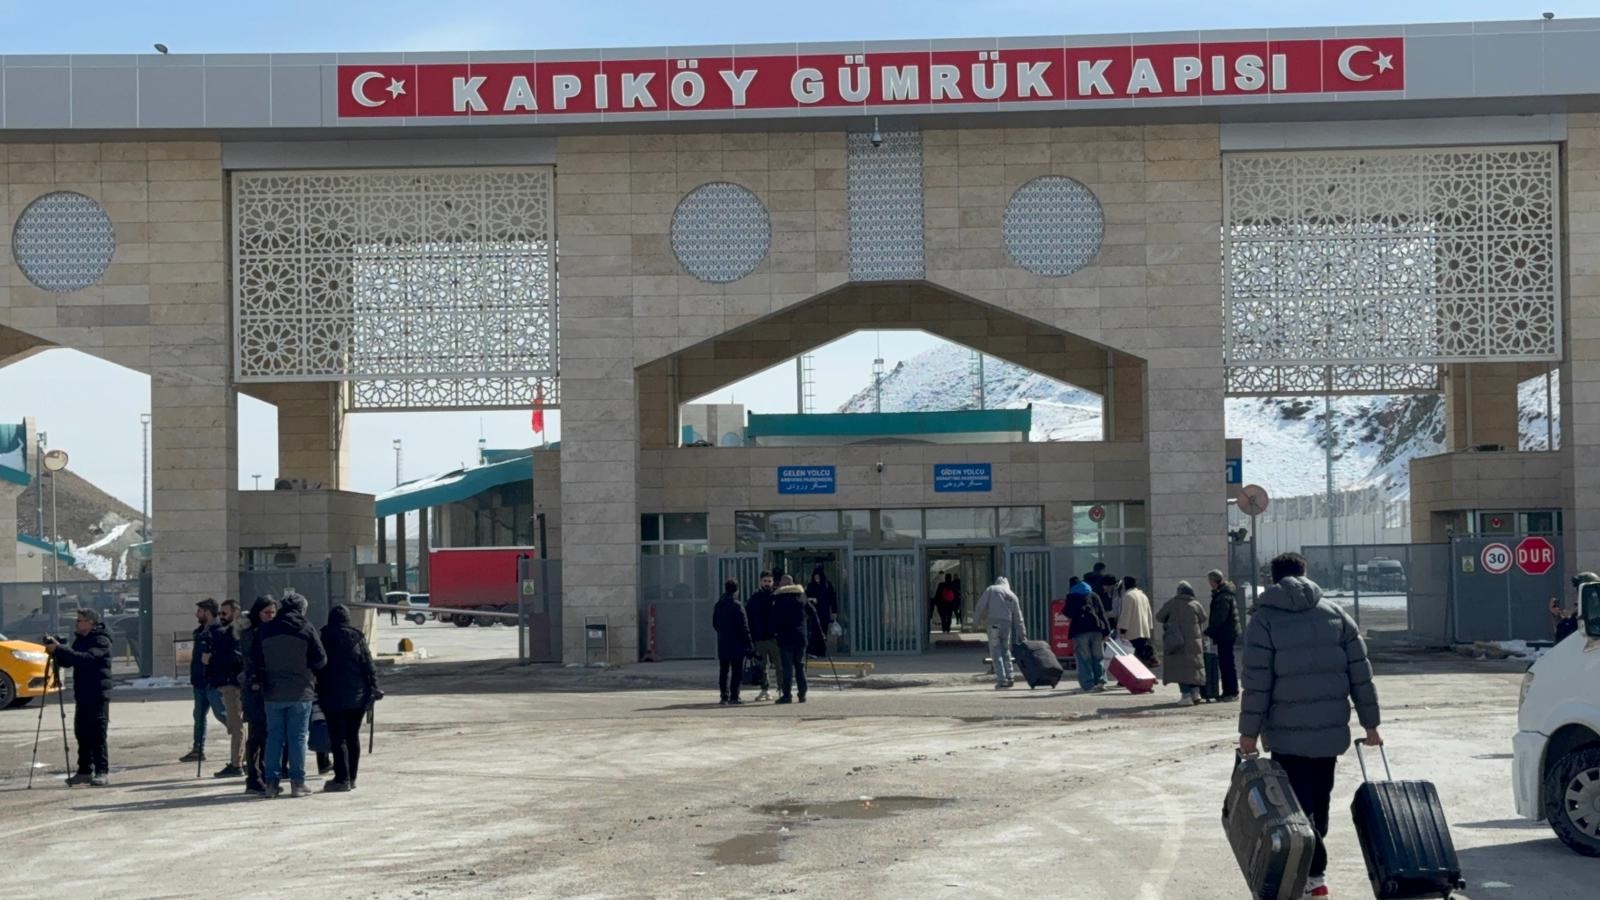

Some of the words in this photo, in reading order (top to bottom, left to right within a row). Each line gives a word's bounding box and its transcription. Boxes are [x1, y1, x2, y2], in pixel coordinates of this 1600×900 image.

[452, 60, 758, 112] KAPIKÖY
[790, 51, 1053, 104] GÜMRÜK
[1077, 54, 1287, 96] KAPISI
[783, 469, 806, 477] GELEN
[807, 469, 830, 477] YOLCU
[1488, 553, 1506, 564] 30
[1518, 548, 1552, 563] DUR
